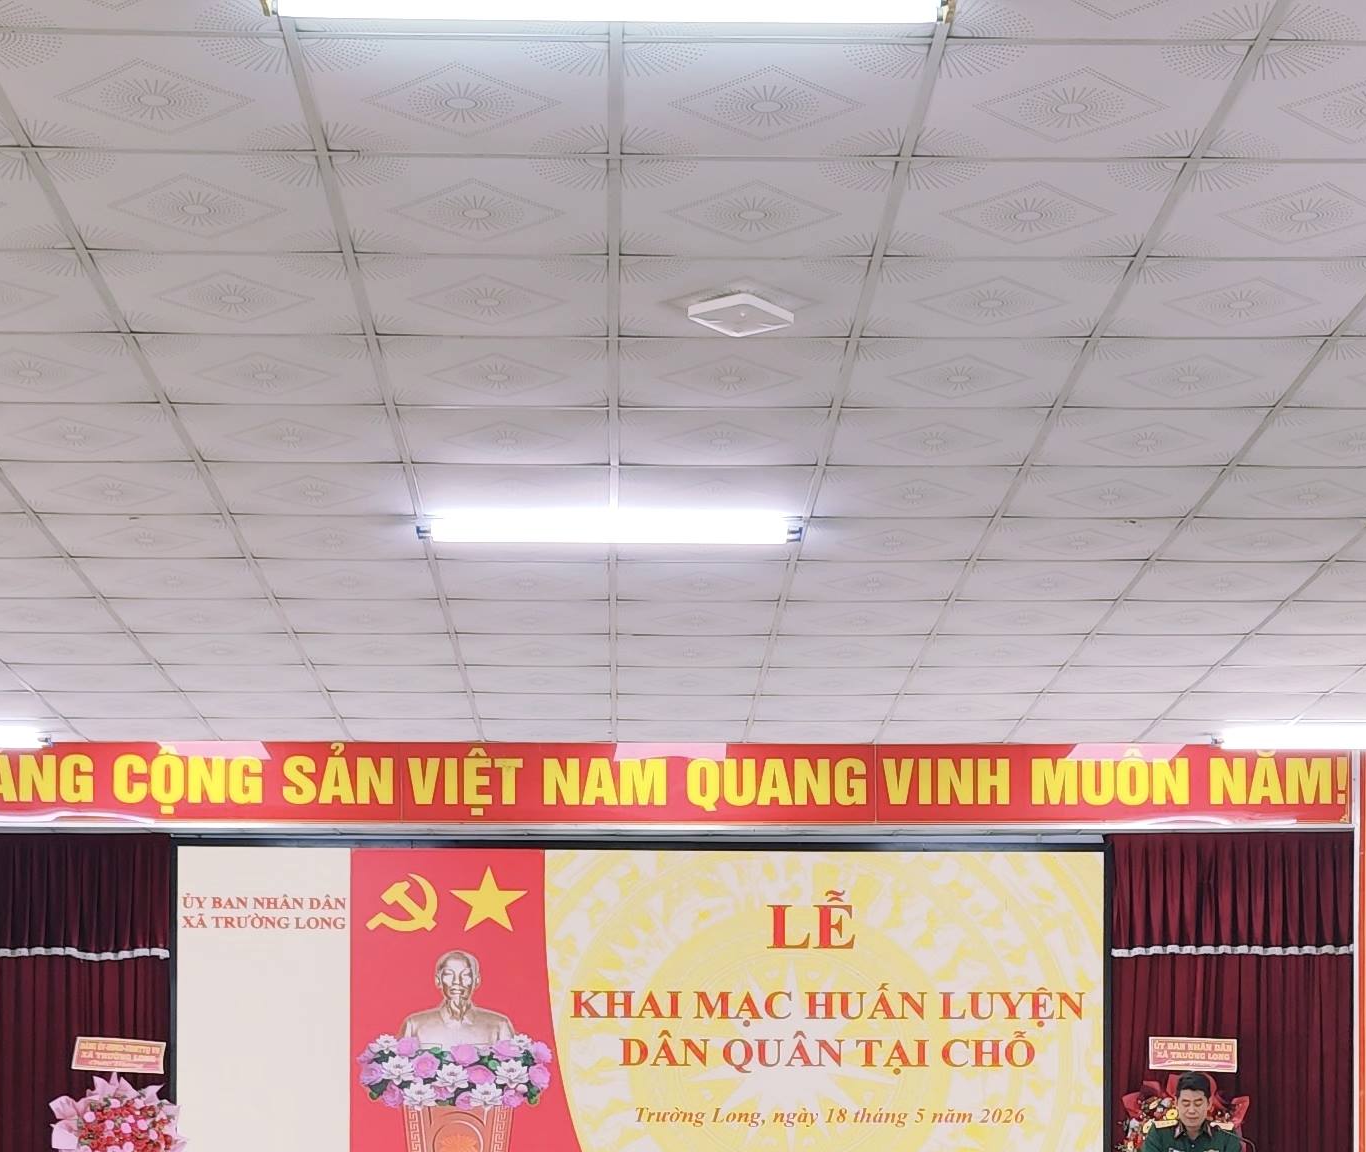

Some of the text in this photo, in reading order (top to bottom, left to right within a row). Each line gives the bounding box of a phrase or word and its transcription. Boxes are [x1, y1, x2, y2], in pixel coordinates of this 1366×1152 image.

[113, 746, 263, 814] CỘNG
[283, 742, 394, 805] SẢN
[408, 748, 523, 816] VIỆT
[543, 758, 667, 805] NAM
[686, 757, 866, 811] QUANG
[883, 758, 1010, 805] VINH
[1032, 748, 1190, 805] MUÔN
[1210, 750, 1347, 805] NĂM!
[182, 913, 346, 929] XÃ TRƯỜNG LONG
[211, 897, 247, 909] BAN
[253, 894, 305, 909] NHÂN
[309, 894, 346, 909] DÂN
[767, 890, 856, 950] LỄ
[569, 983, 1085, 1028] KHAI MẠC HUẤN LUYỆN
[618, 1030, 1036, 1075] DÂN QUÂN TẠI CHỖ
[634, 1107, 1025, 1127] Trường Long, ngày 18 tháng 5 năm 2026
